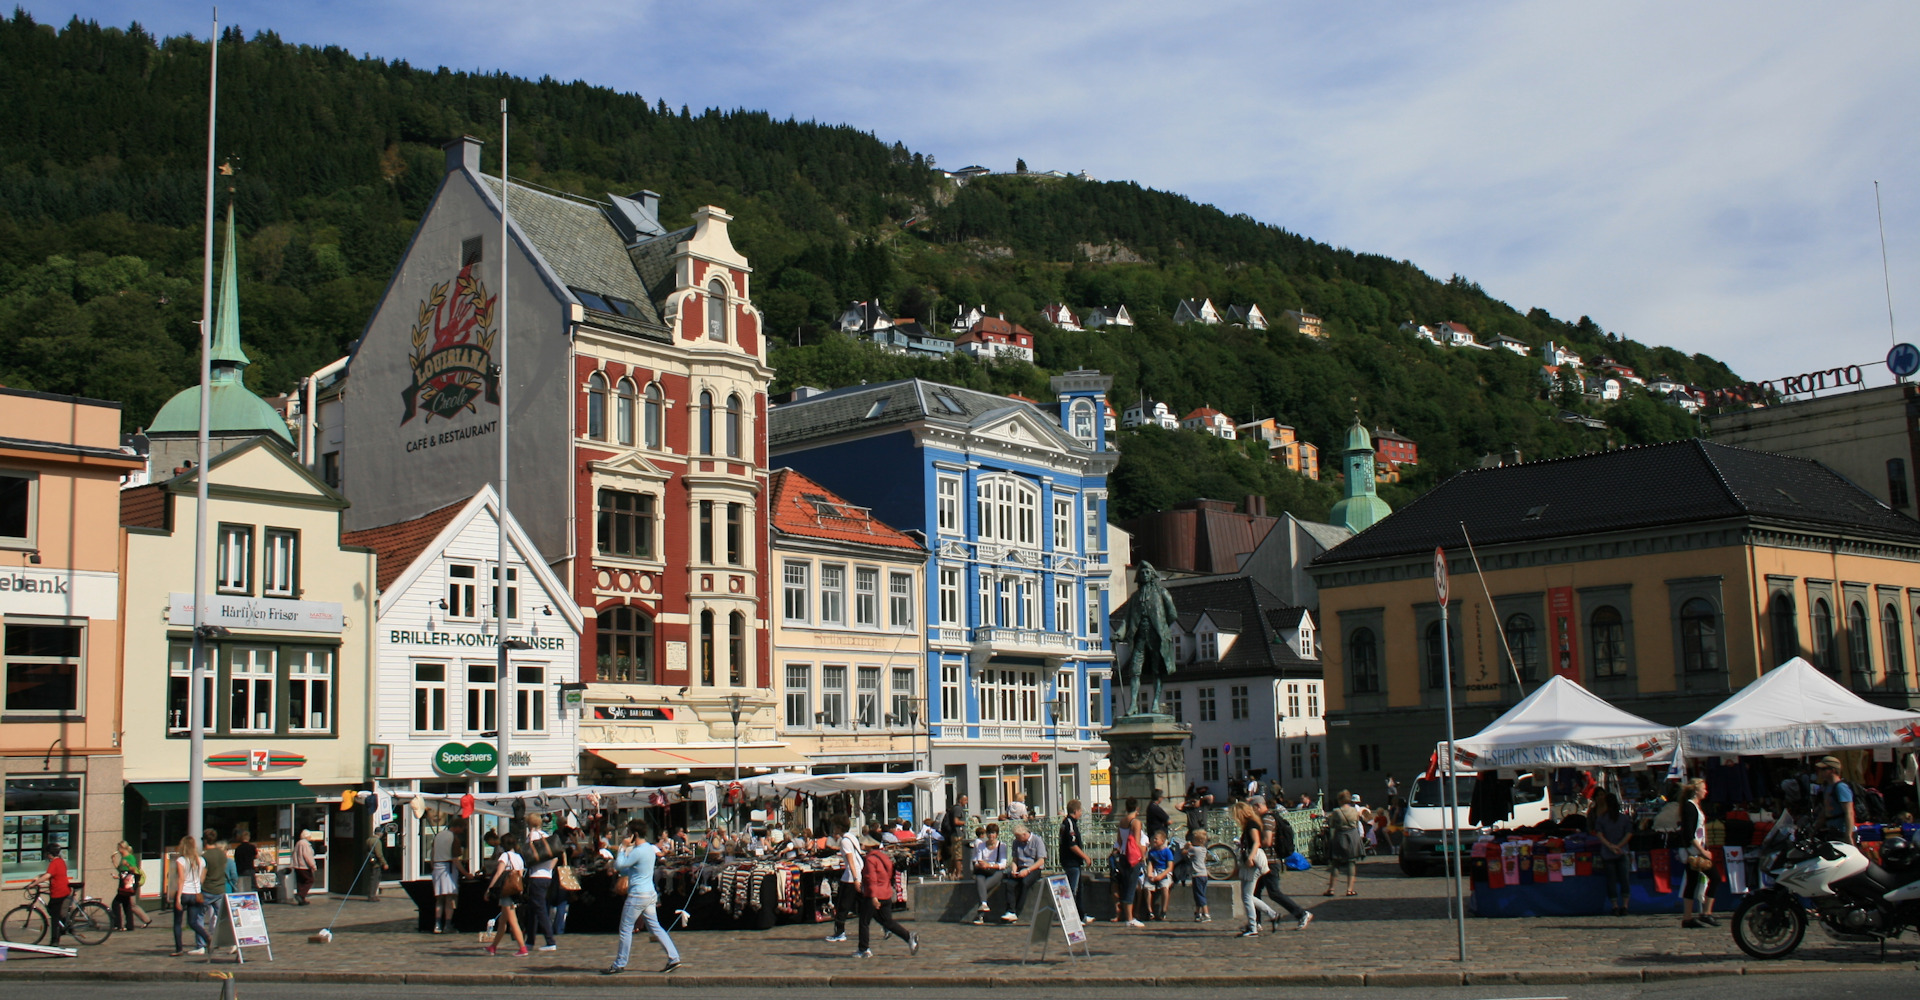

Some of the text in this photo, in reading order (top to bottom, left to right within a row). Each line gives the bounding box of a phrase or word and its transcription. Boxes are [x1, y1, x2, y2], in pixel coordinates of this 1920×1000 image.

[415, 348, 488, 387] LOUISIANA
[1781, 365, 1862, 395] ROTTO
[429, 435, 436, 448] &
[438, 421, 498, 445] RESTAURANT
[0, 573, 68, 594] ebank
[1708, 733, 1741, 751] ACCEPT
[253, 751, 267, 771] 7
[372, 748, 385, 776] 7
[442, 752, 492, 764] Specsavers
